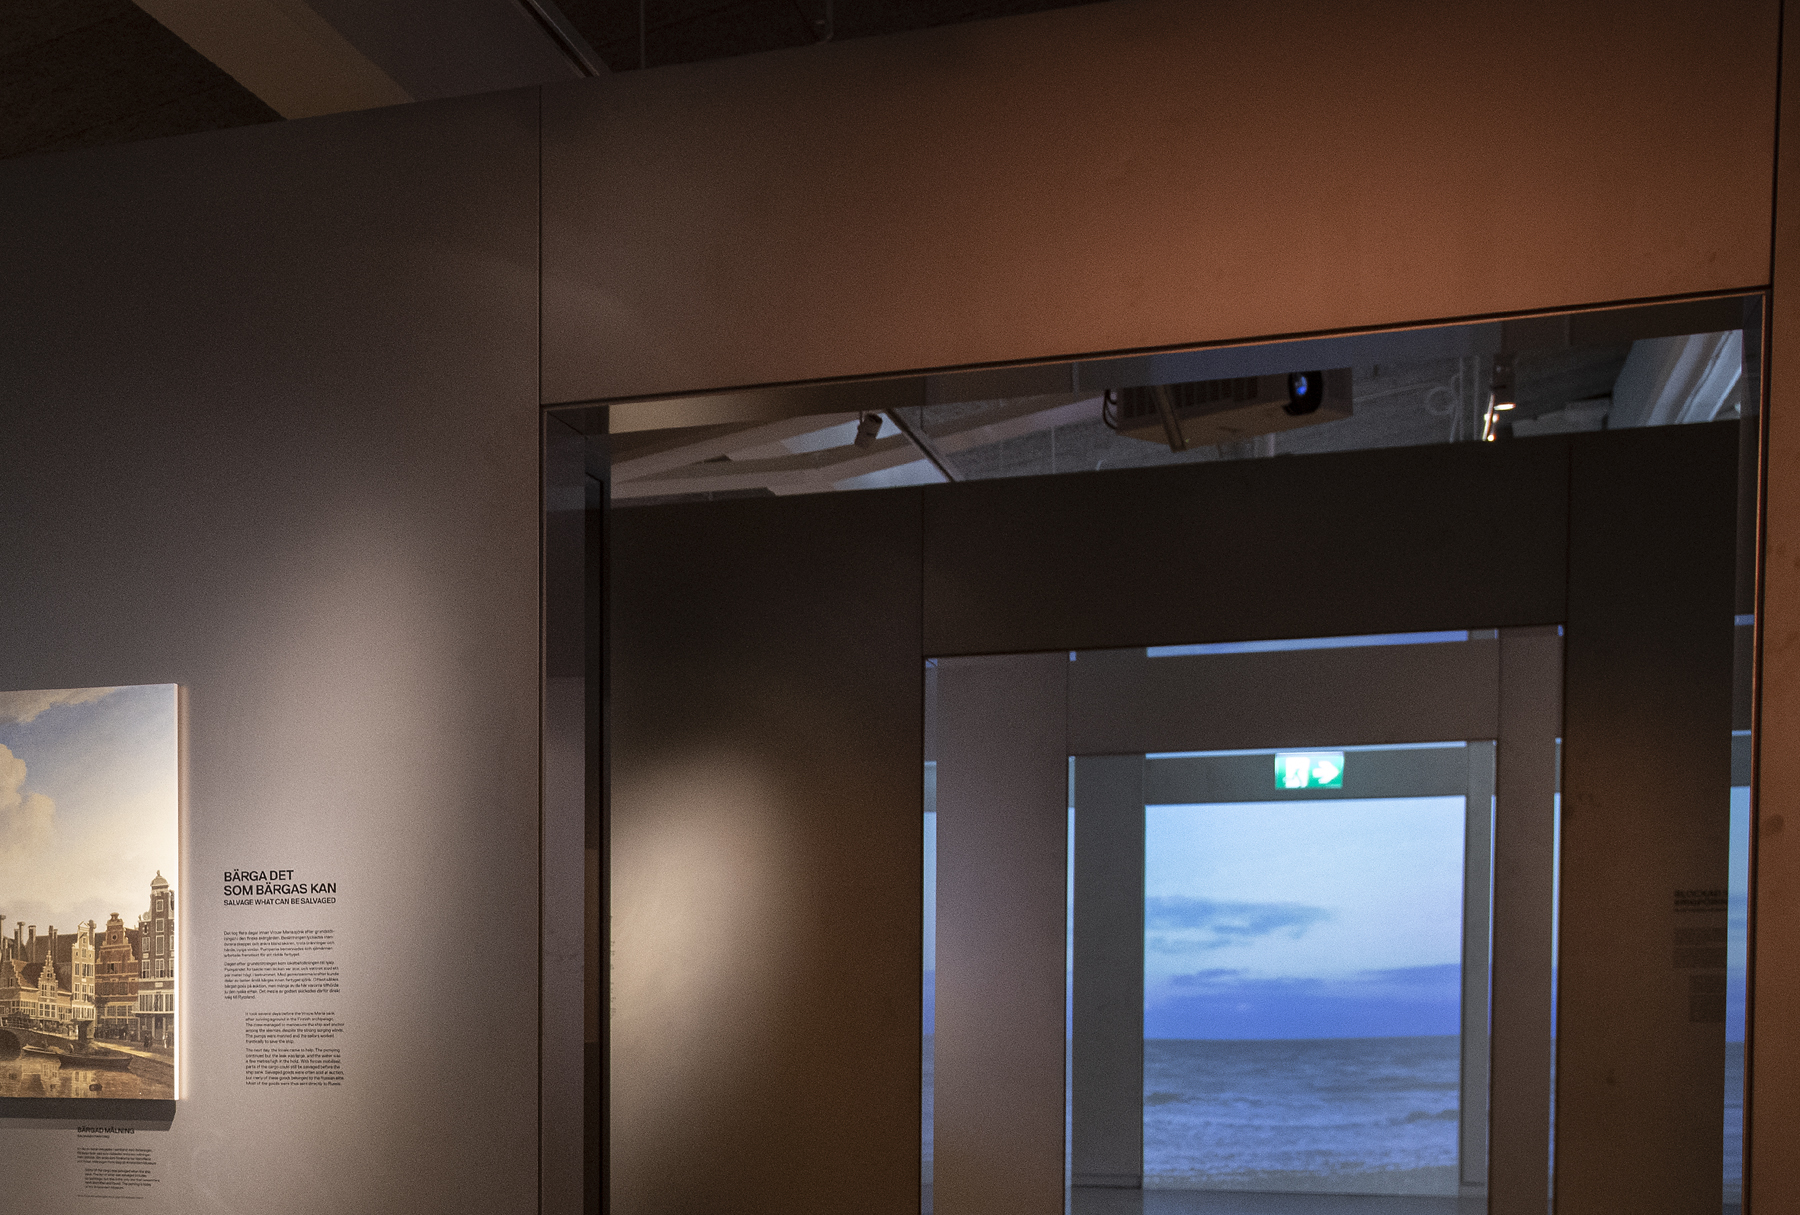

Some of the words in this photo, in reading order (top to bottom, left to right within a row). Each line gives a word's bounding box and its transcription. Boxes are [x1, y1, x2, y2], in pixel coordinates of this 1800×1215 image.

[224, 869, 267, 882] BÄRGA
[270, 870, 293, 881] DET
[224, 885, 253, 895] SOM
[256, 882, 308, 895] BÄRGAS
[310, 883, 336, 894] KAN
